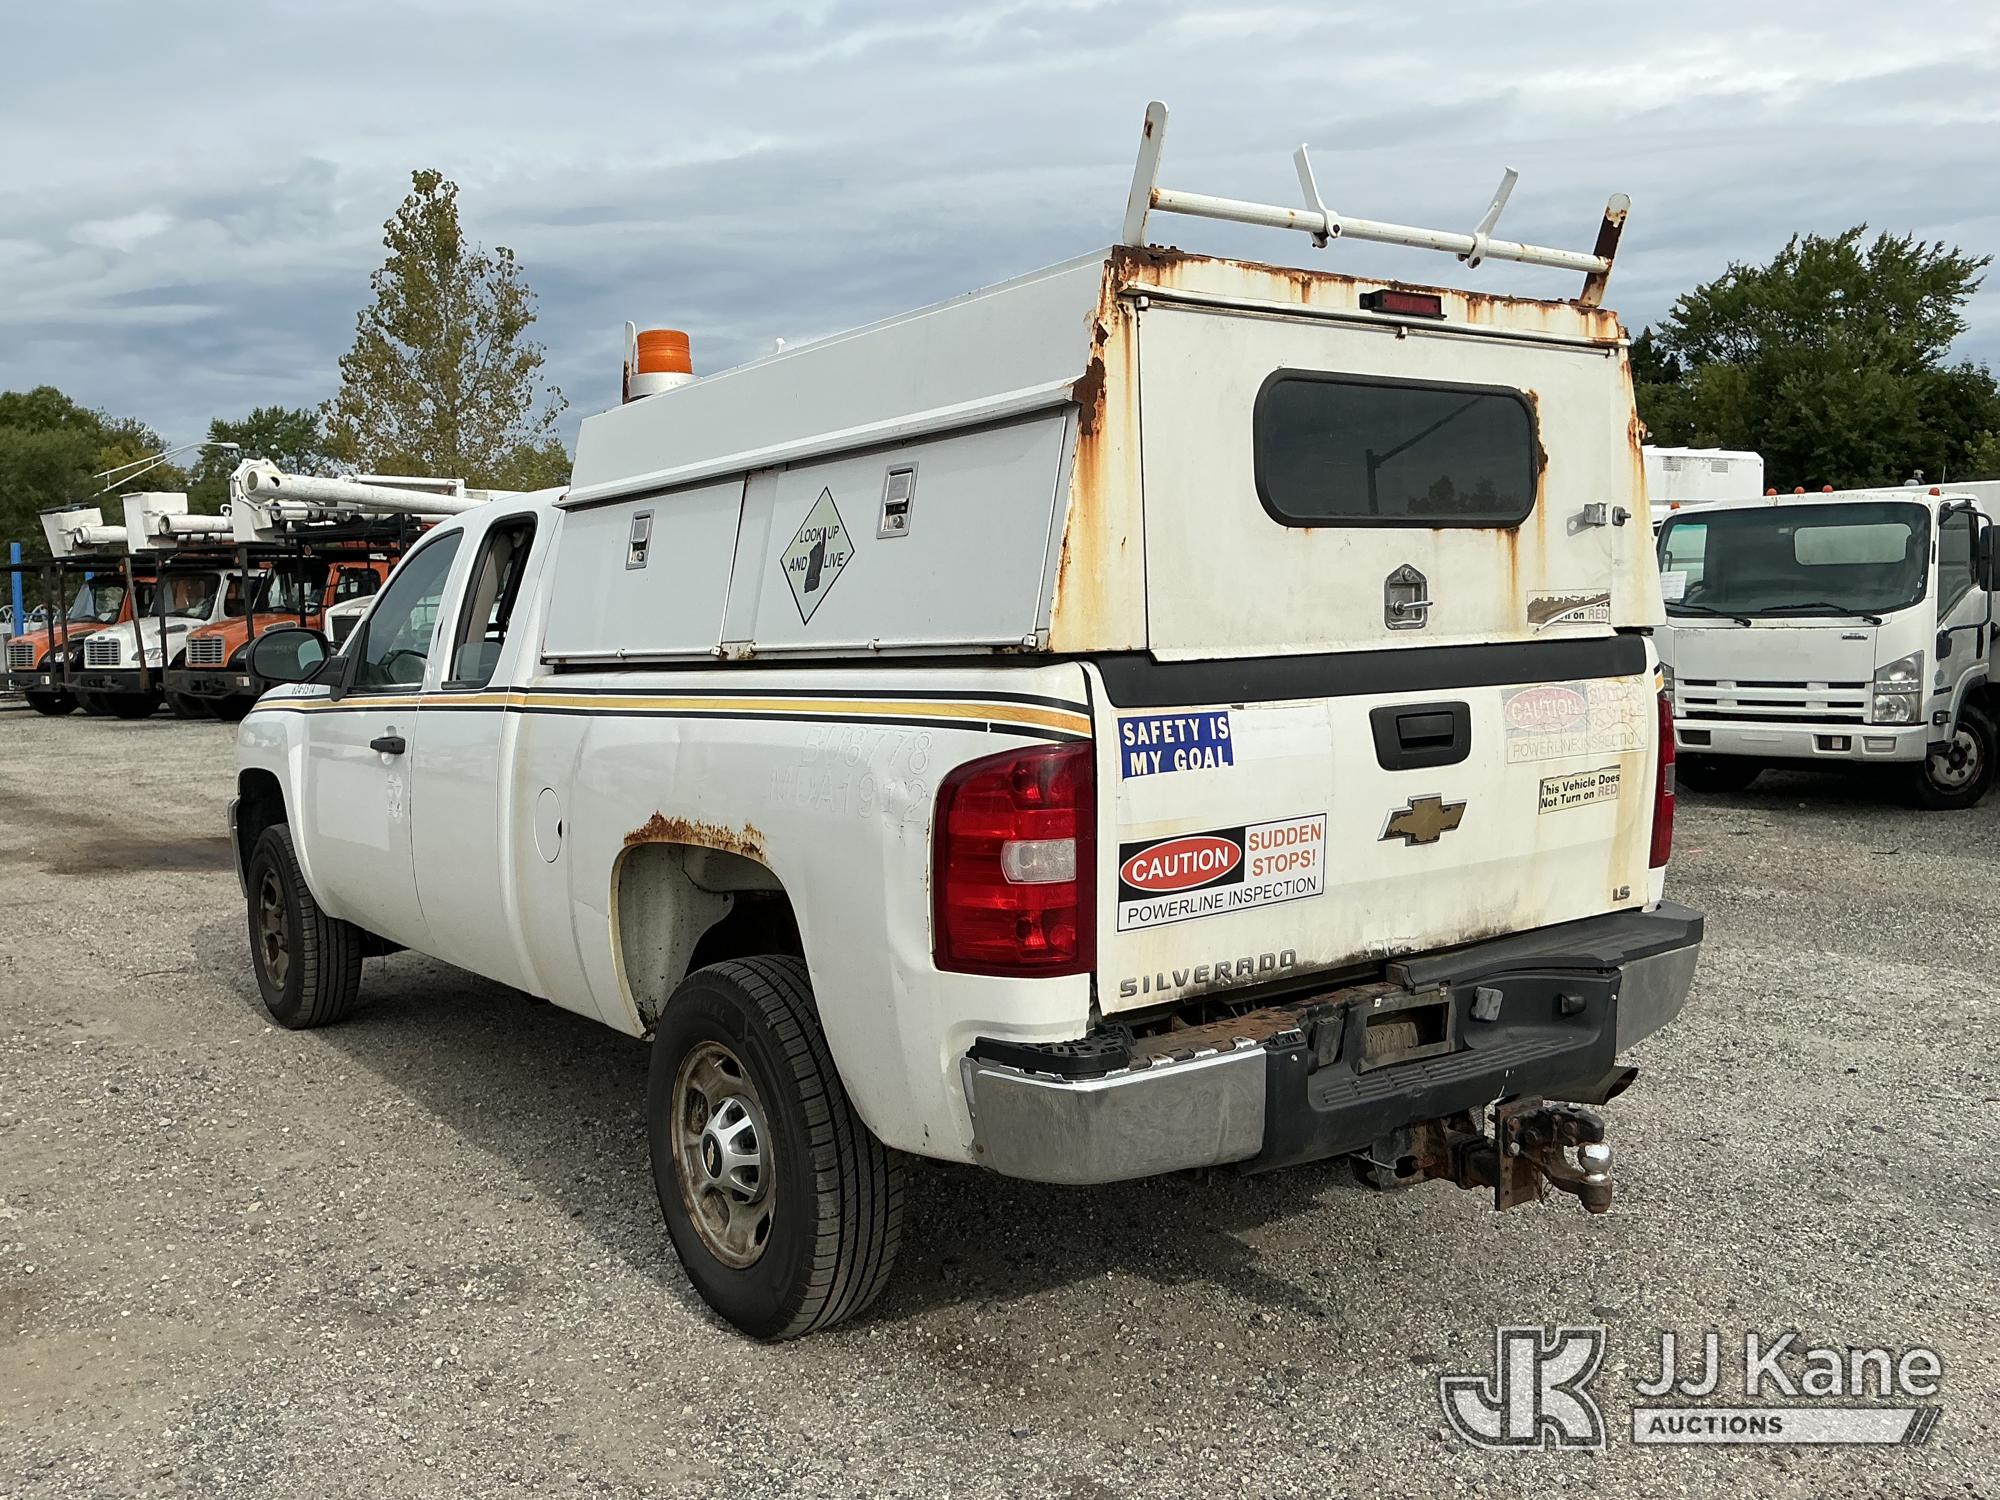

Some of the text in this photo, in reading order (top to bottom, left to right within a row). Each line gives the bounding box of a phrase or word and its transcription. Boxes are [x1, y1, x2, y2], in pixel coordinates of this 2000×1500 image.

[799, 525, 840, 543] LOOK UP
[788, 552, 845, 572] AND LIVE
[1573, 612, 1584, 620] on
[1588, 609, 1608, 620] RED
[1511, 697, 1578, 721] CAUTION
[1123, 716, 1230, 747] SAFETY IS
[1130, 746, 1229, 776] MY GOAL
[1540, 783, 1617, 809] Not Turn on RED
[1562, 777, 1596, 792] Vehicle
[1598, 774, 1620, 785] Does
[1248, 823, 1322, 851] SUDDEN
[1132, 846, 1229, 882] CAUTION
[1252, 849, 1316, 877] STOPS!
[1128, 876, 1317, 924] POWERLINE INSPECTION
[1612, 885, 1631, 901] LS
[1119, 948, 1297, 998] SILVERADO
